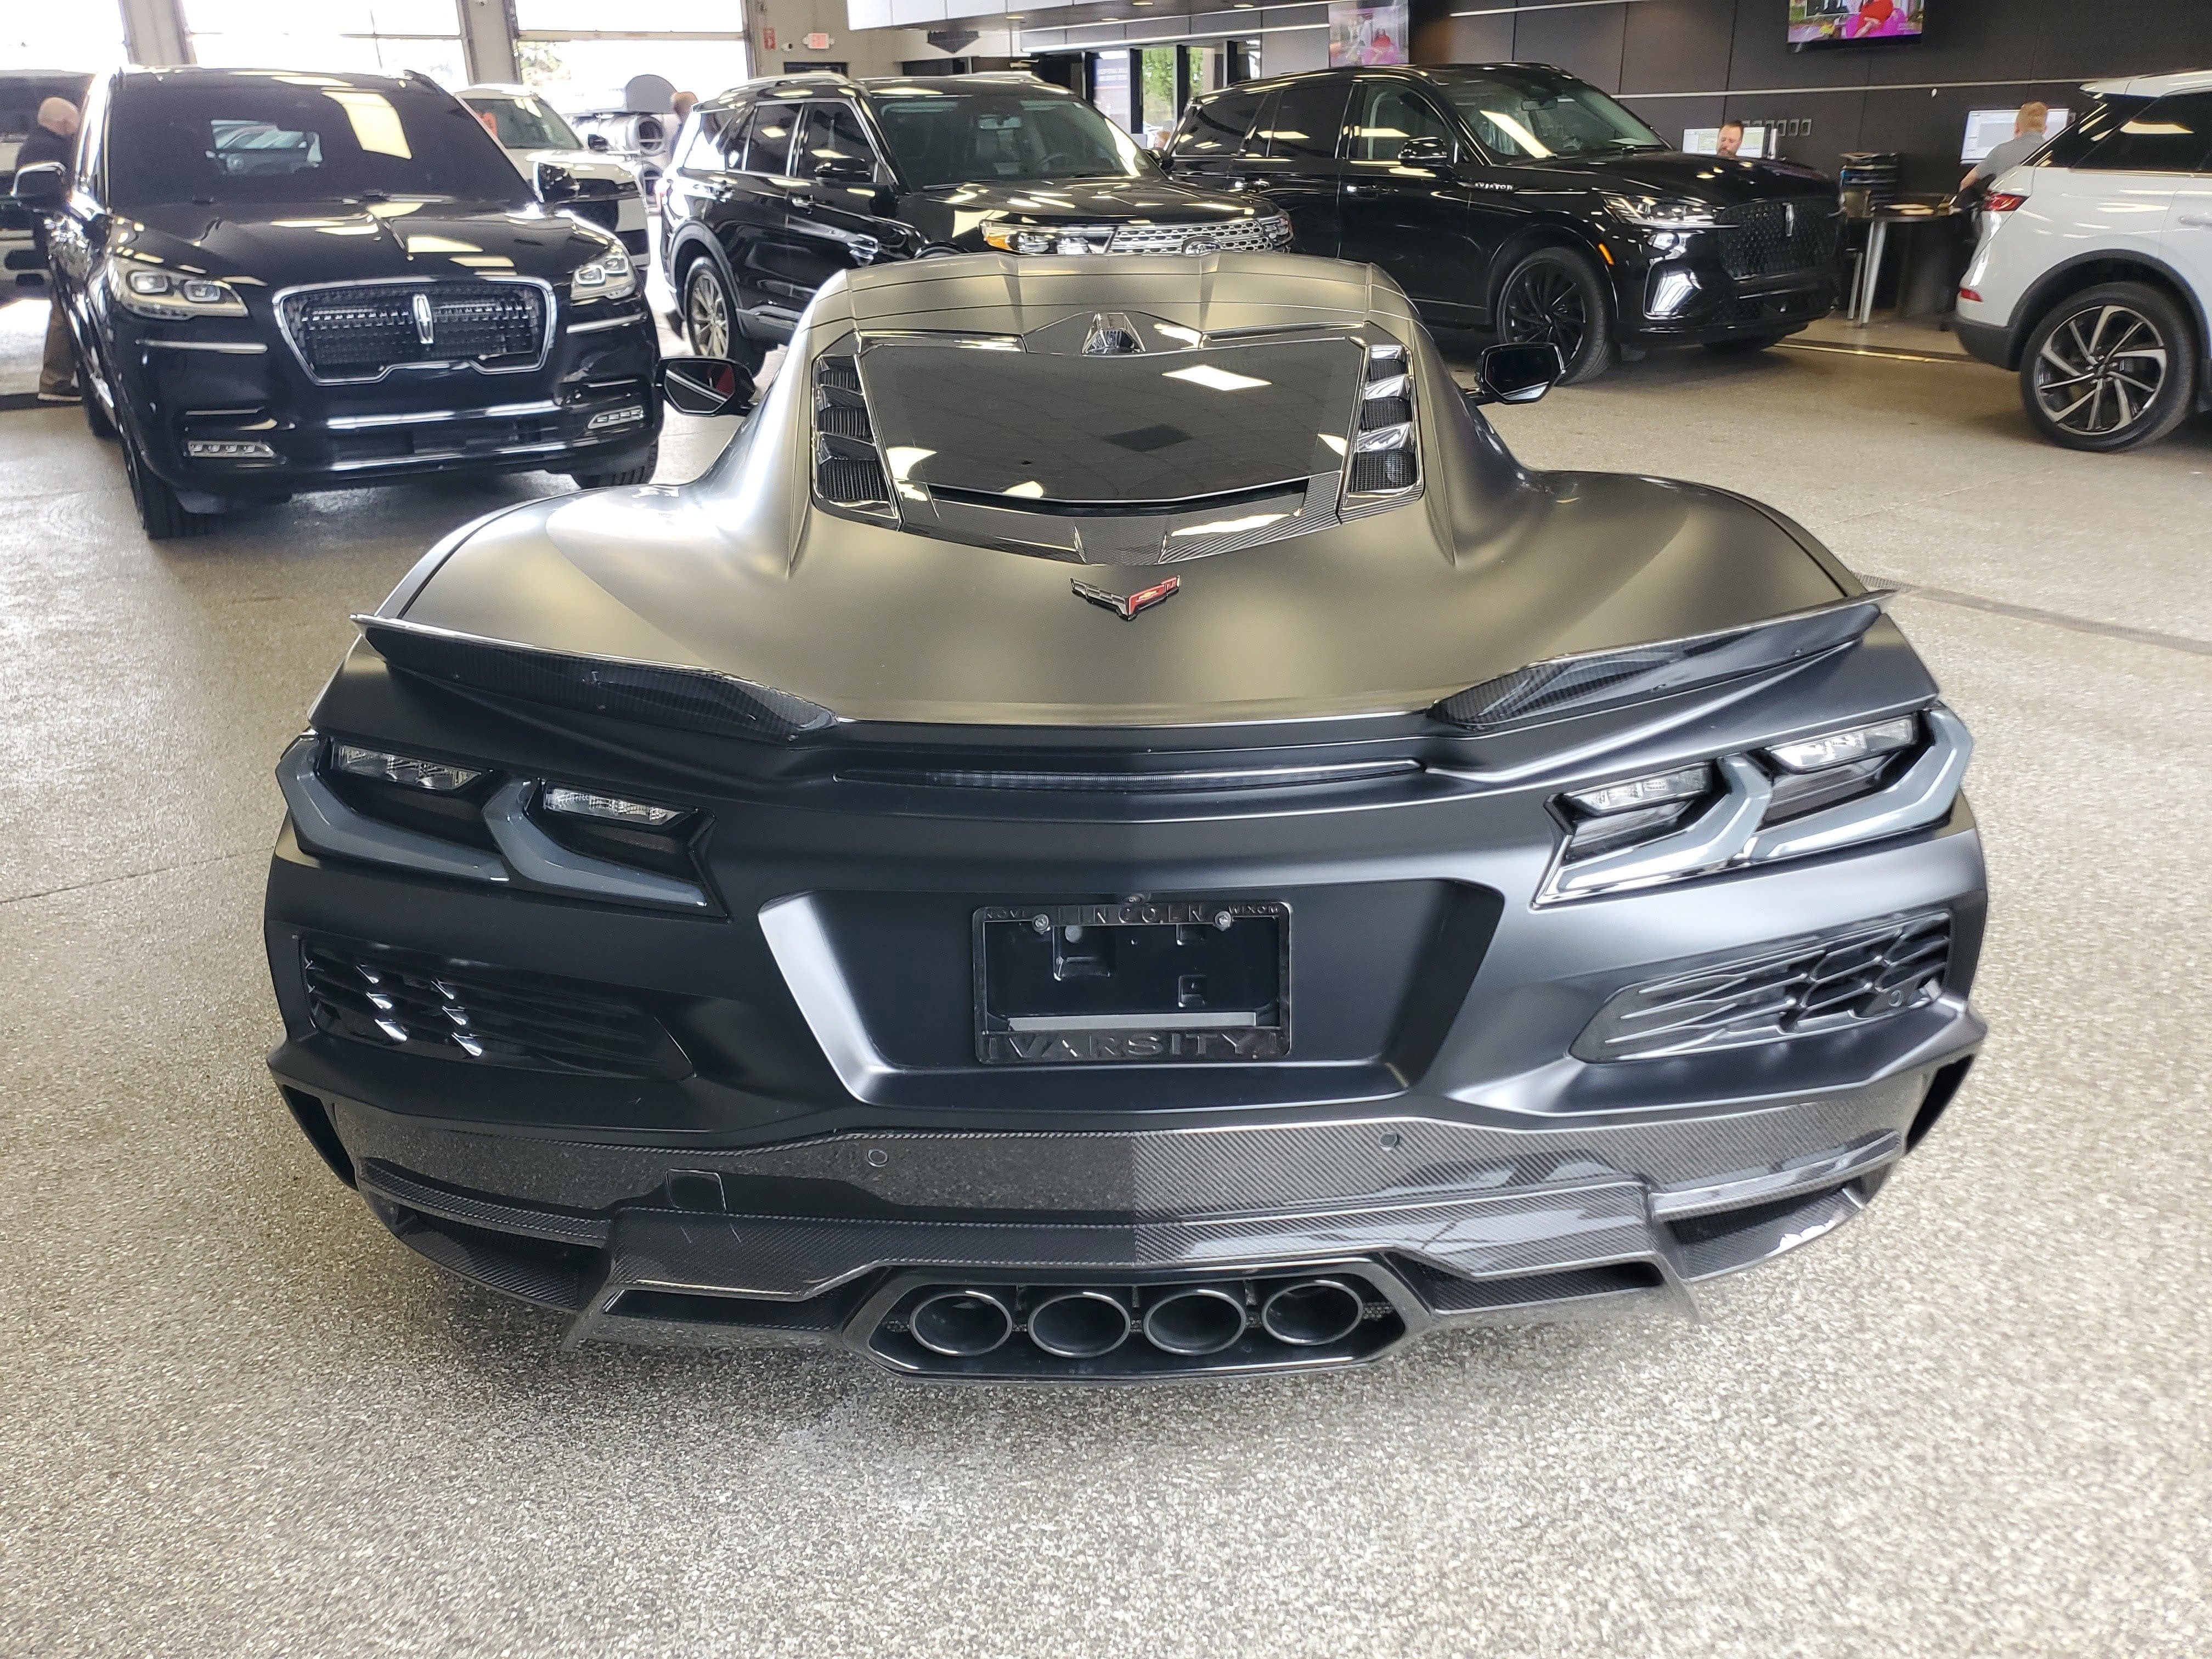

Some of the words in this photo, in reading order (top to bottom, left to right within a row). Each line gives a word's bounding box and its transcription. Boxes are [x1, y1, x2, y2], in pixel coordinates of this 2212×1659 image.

[1474, 182, 1513, 190] AVIATOR
[984, 909, 1025, 919] NOVI
[1057, 905, 1204, 923] LINCOLN
[1228, 905, 1279, 915] WIXOM
[1008, 1032, 1256, 1059] VARSITY
